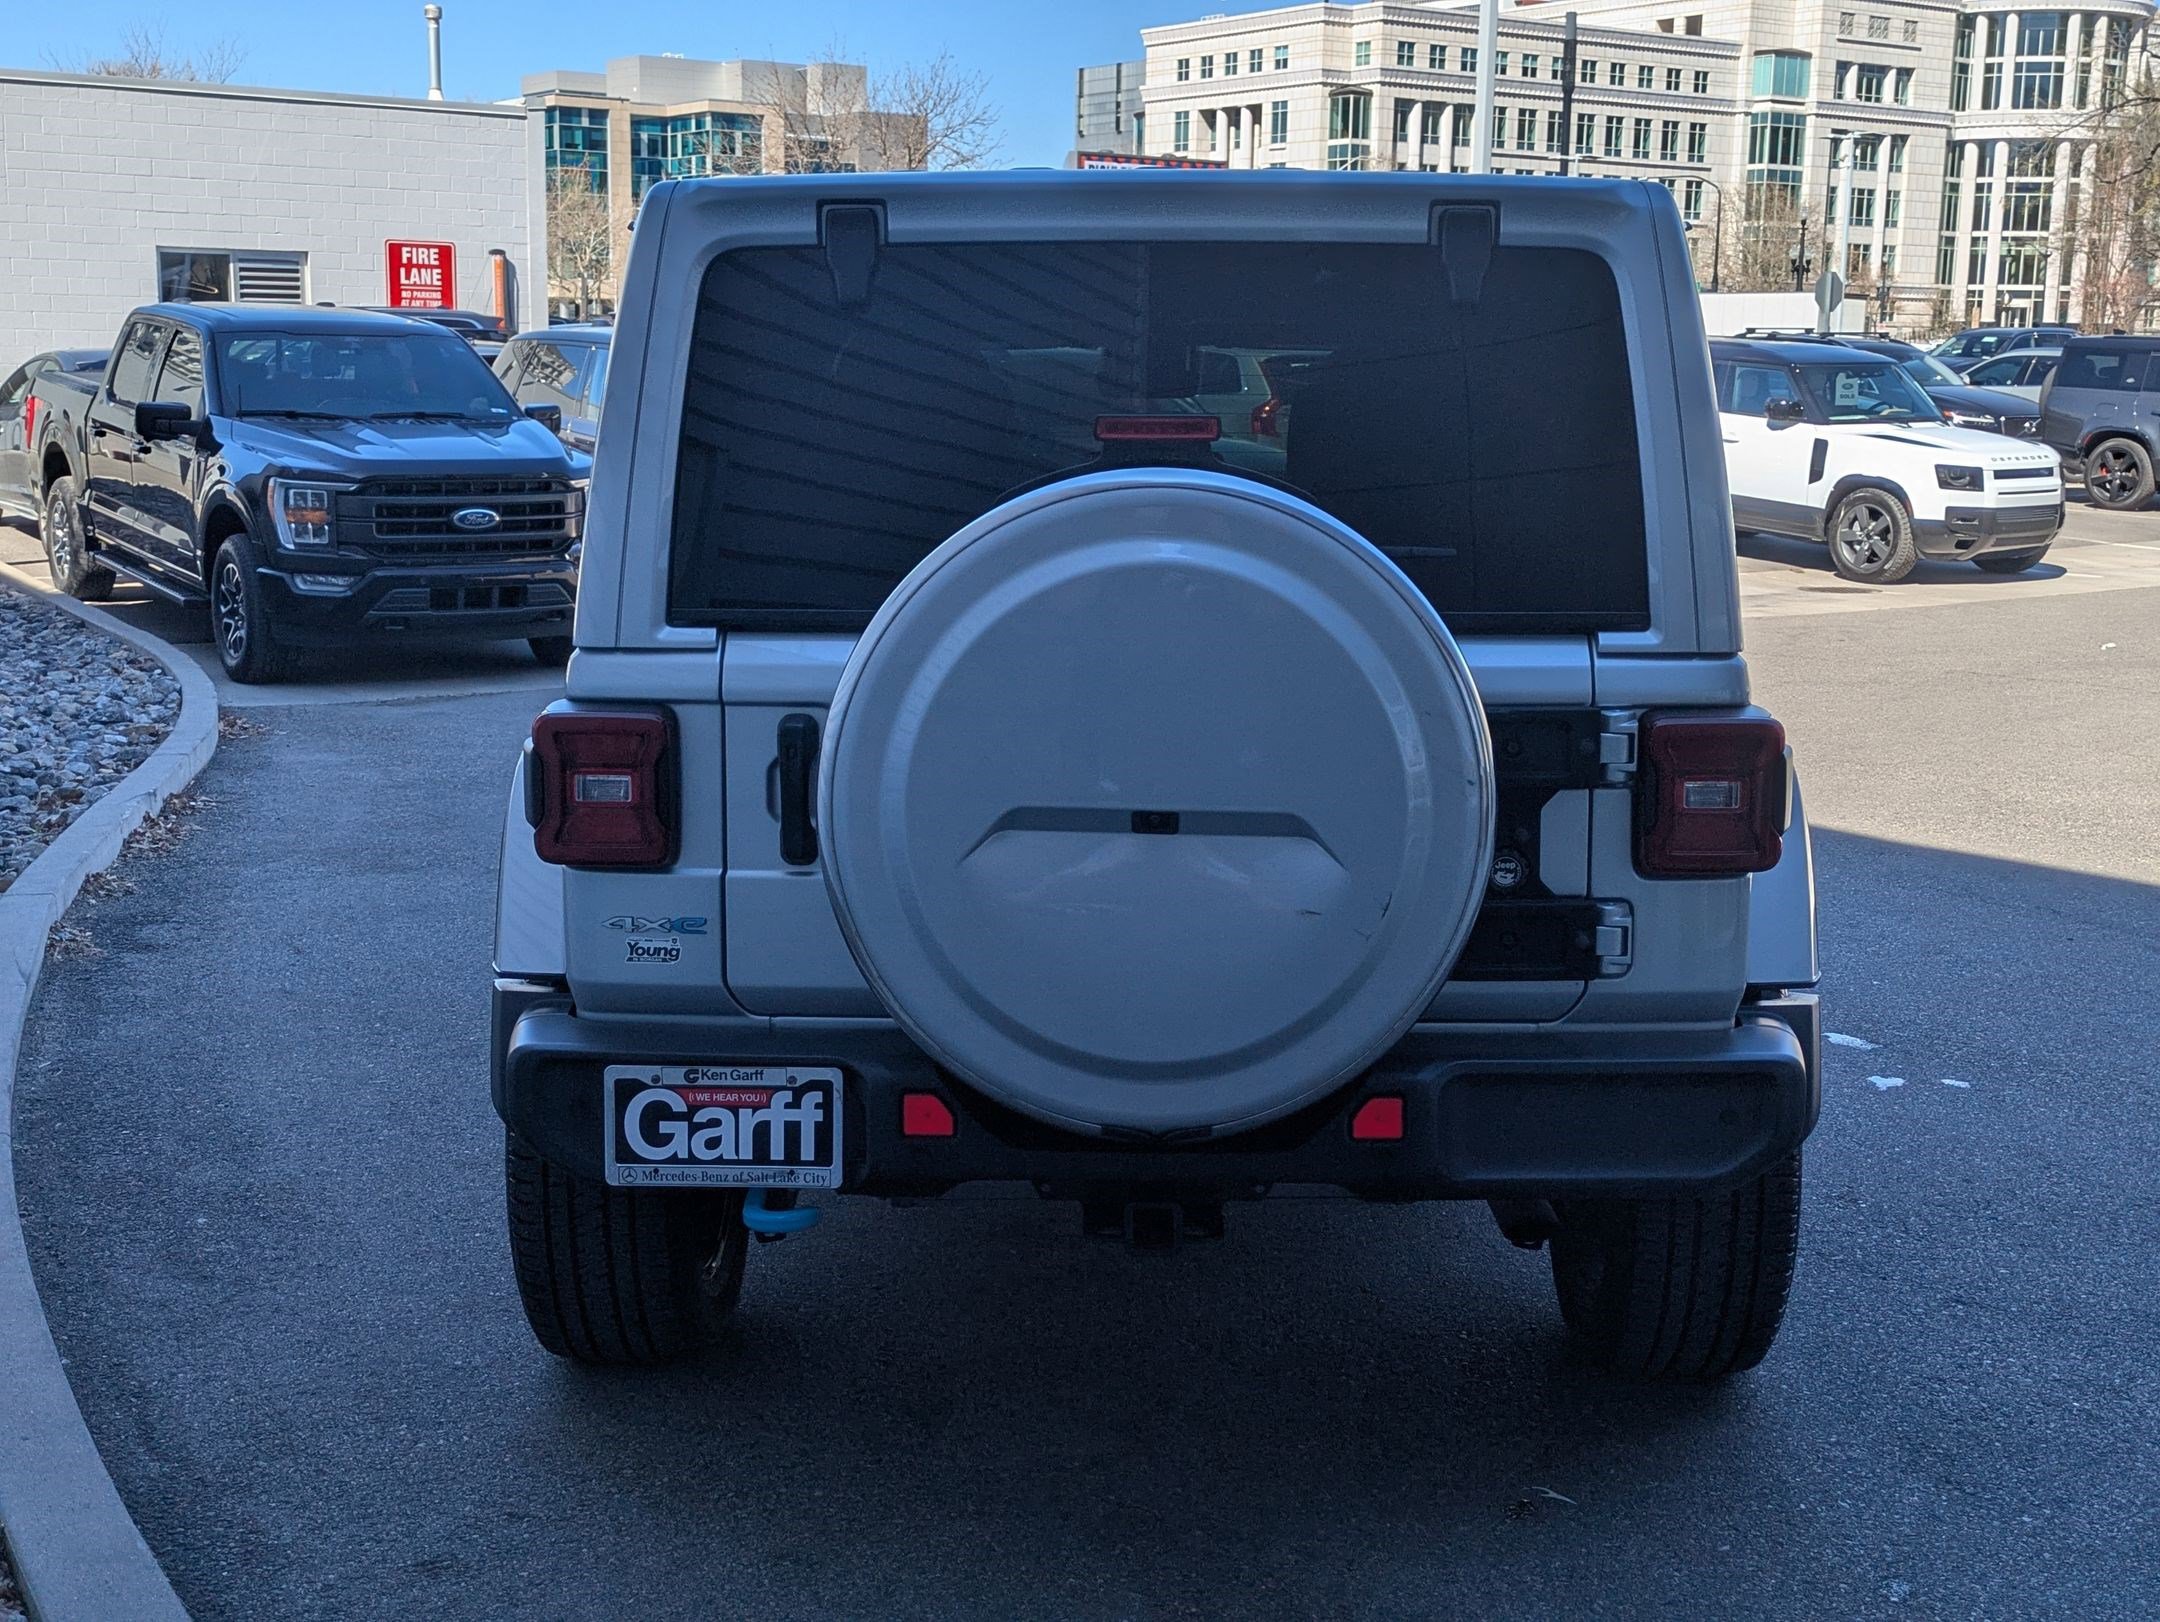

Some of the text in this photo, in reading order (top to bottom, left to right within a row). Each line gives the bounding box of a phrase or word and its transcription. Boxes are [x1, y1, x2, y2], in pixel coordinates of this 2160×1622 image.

[401, 247, 440, 265] FIRE
[400, 267, 442, 286] LANE
[401, 290, 442, 299] NO PARKING
[400, 299, 410, 307] AT
[410, 299, 424, 307] ANY
[1991, 454, 2050, 462] DEFENDER
[464, 513, 489, 524] Ford
[1494, 861, 1516, 870] Jeep
[626, 941, 680, 961] Young
[701, 1069, 764, 1081] Ken Garff
[696, 1093, 760, 1102] WE HEAR YOU
[624, 1088, 823, 1161] Garff
[641, 1170, 828, 1187] Mercedes-Benz of Salt Lake City
